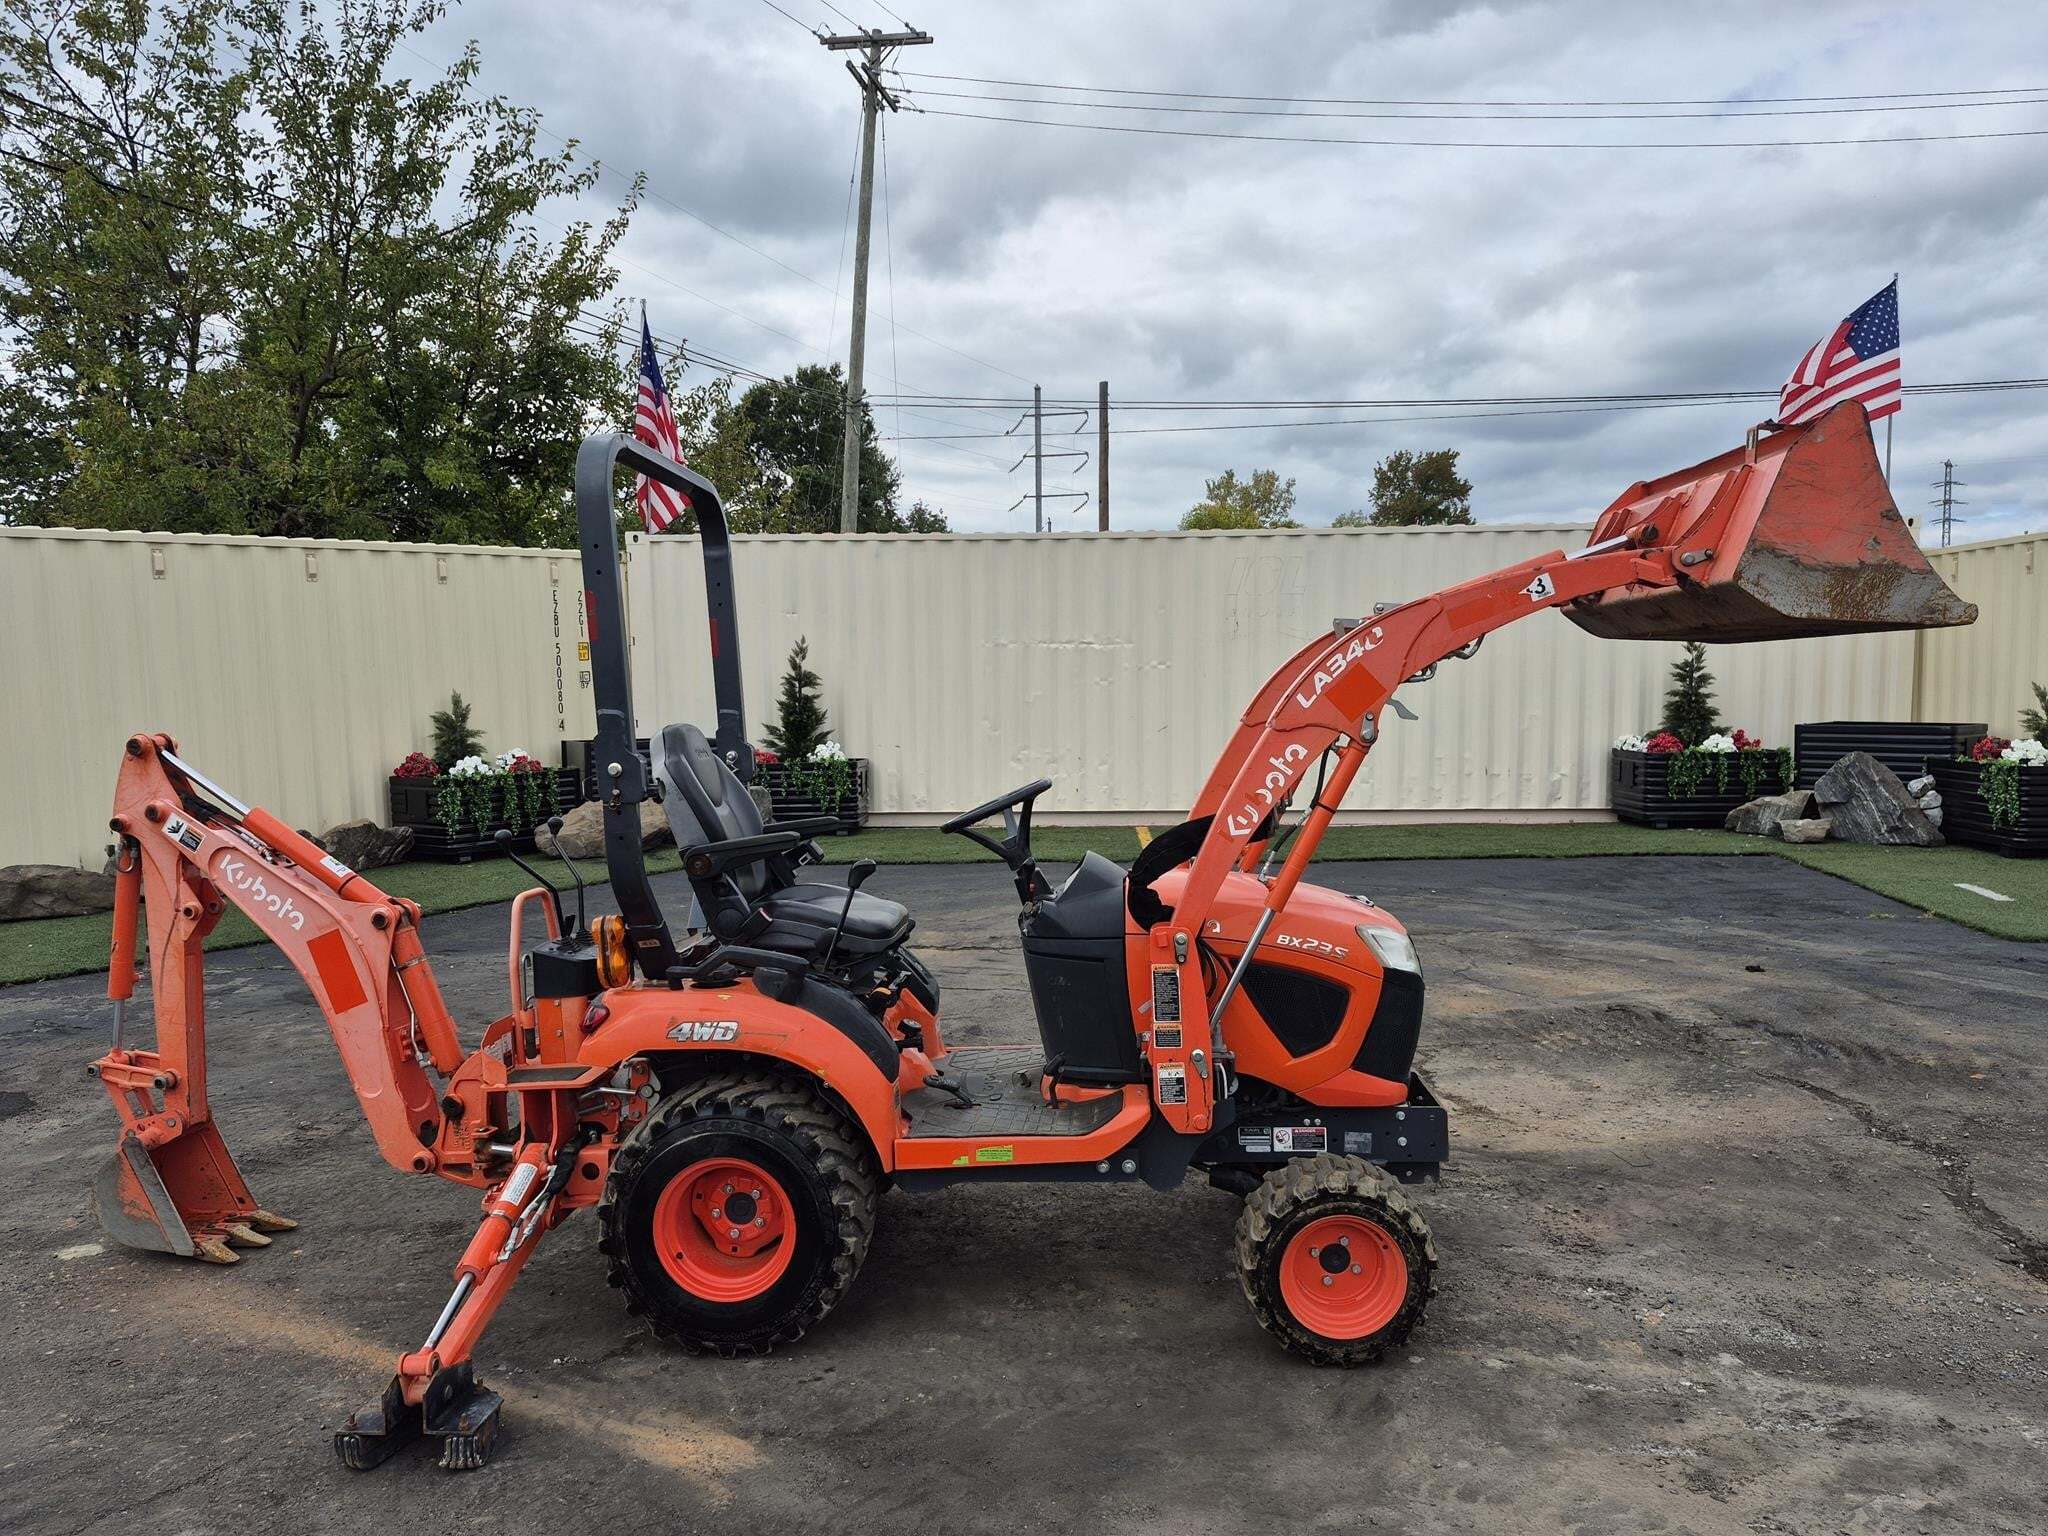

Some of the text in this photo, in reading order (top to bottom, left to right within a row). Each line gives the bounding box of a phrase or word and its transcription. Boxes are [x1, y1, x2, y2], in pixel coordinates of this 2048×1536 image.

[1296, 626, 1385, 709] LA340
[219, 854, 305, 931] Kubota
[1276, 934, 1349, 960] BX23S
[665, 1021, 738, 1042] 4WD
